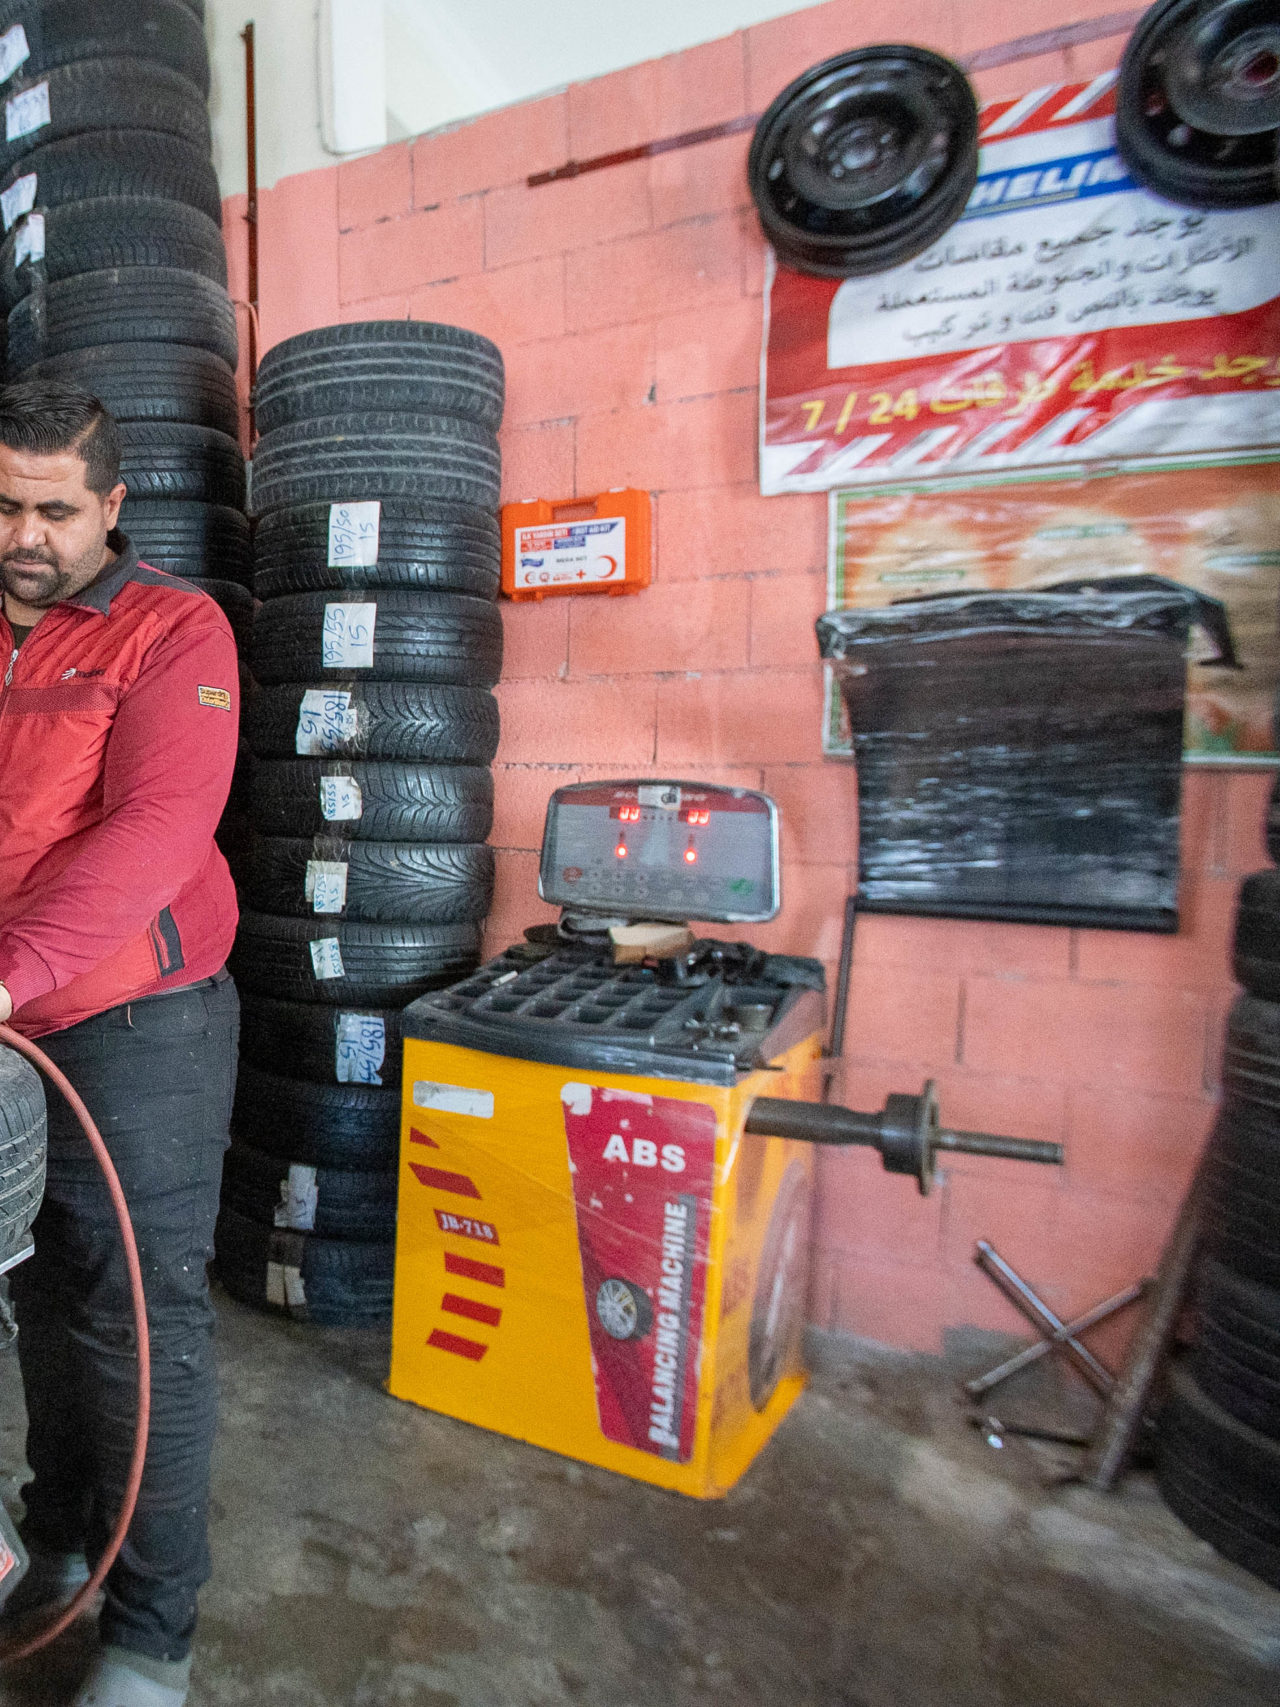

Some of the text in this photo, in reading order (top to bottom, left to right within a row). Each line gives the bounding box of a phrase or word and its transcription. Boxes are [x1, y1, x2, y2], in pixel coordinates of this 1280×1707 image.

[801, 398, 826, 432] 7
[868, 390, 919, 426] 24
[333, 508, 357, 561] 195/50
[359, 521, 375, 539] 15
[323, 607, 345, 666] 195/55
[348, 624, 368, 647] 15
[301, 710, 322, 735] 15
[340, 1039, 358, 1060] 15
[358, 1020, 384, 1084] 185/55
[602, 1134, 687, 1174] ABS
[647, 1201, 688, 1450] BALANCING MACHINE
